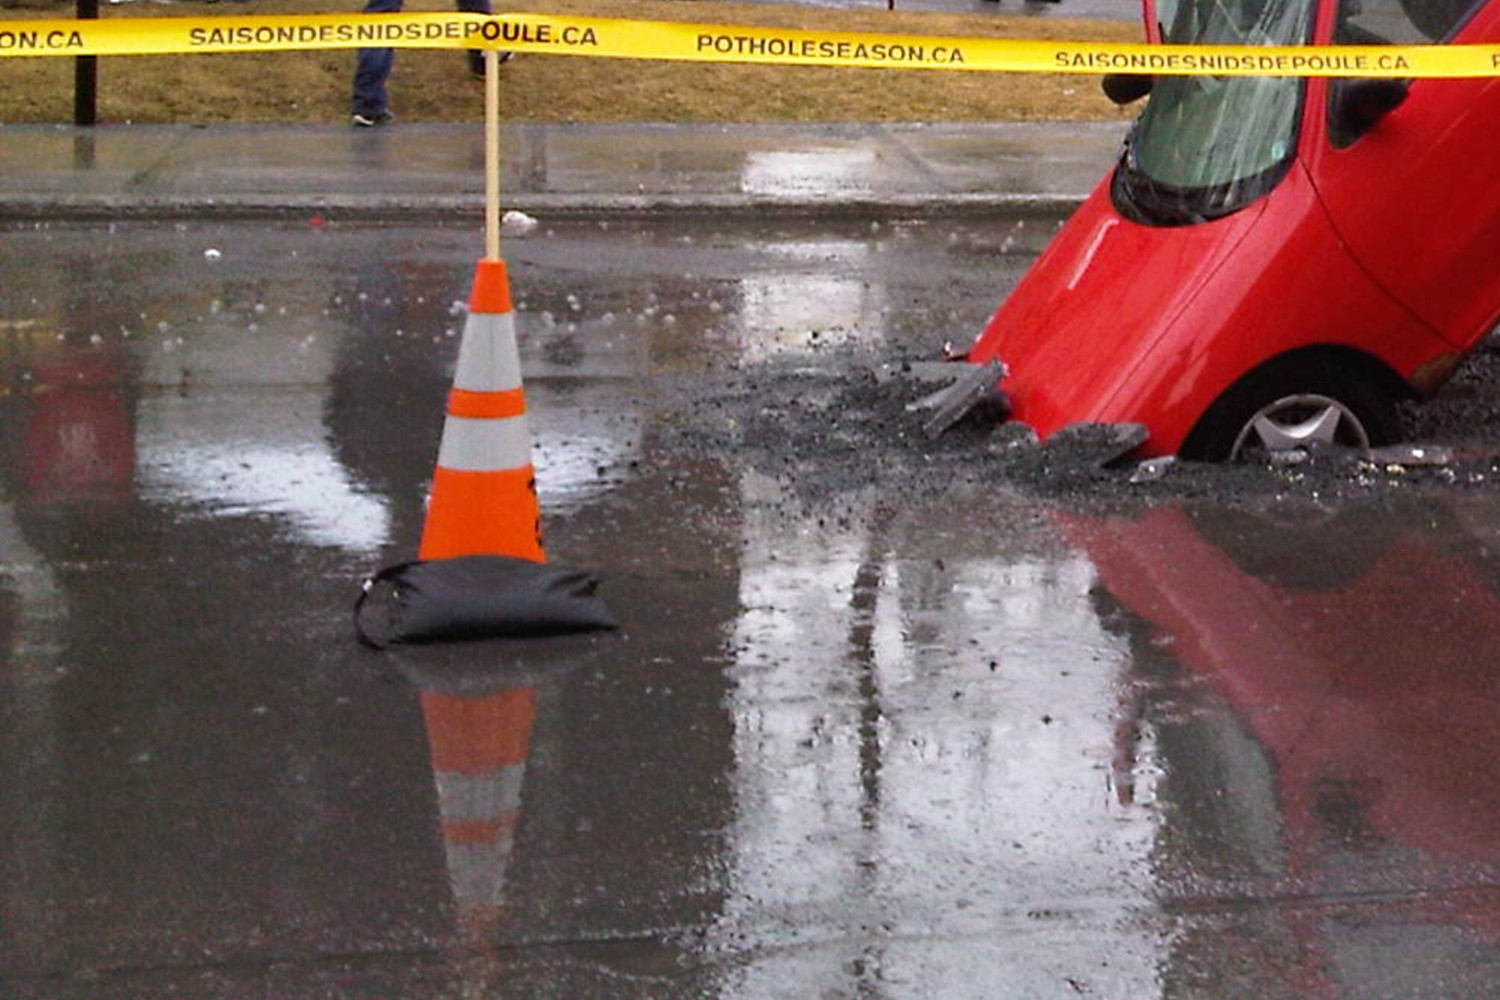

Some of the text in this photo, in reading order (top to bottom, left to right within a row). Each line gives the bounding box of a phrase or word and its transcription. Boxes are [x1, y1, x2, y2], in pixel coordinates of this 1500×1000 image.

[190, 20, 598, 46] SAISONDESNIDSDEPOULE.CA
[696, 34, 965, 64] POTHOLESEASON.CA
[1055, 51, 1411, 72] SAISONDESNIDSDEPOULE.CA
